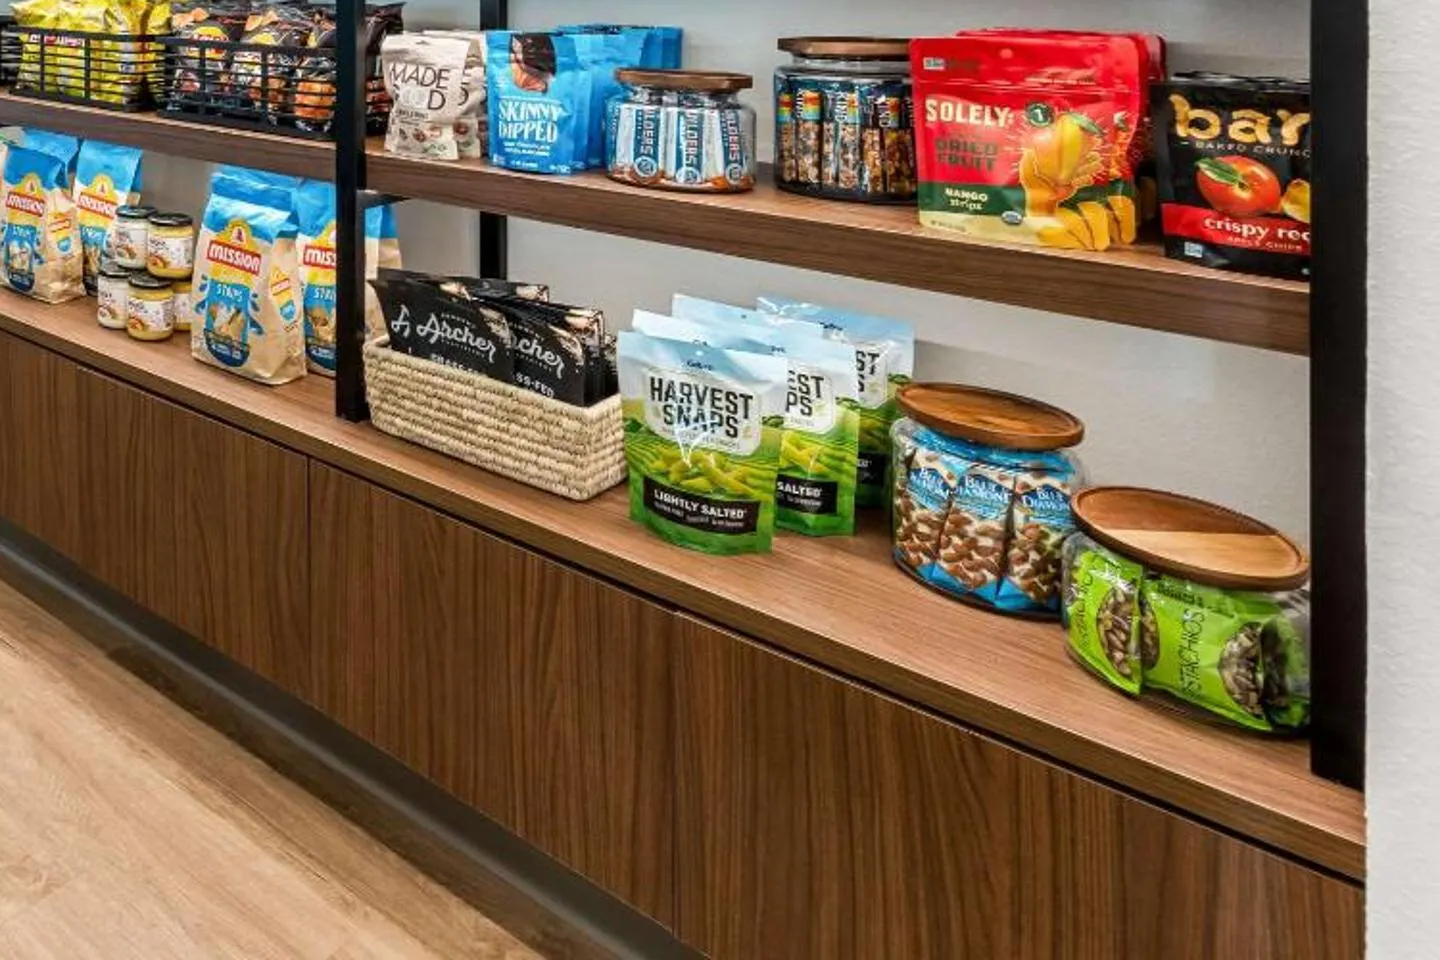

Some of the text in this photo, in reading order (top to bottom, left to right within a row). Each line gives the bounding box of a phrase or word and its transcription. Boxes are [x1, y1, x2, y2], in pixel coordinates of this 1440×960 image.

[389, 62, 450, 90] MADE
[498, 100, 560, 122] SKINNY
[924, 97, 1010, 128] SOLELY
[1168, 93, 1310, 146] bar
[498, 120, 558, 143] DIPPED
[1252, 145, 1310, 159] CRUNC
[944, 187, 988, 202] MANGO
[1204, 217, 1270, 239] crispy
[416, 313, 496, 365] Archer
[511, 335, 565, 380] cher
[649, 375, 754, 420] HARVEST
[662, 403, 739, 439] SNAPS
[654, 489, 700, 513] LIGHTLY
[701, 506, 746, 521] SALTED
